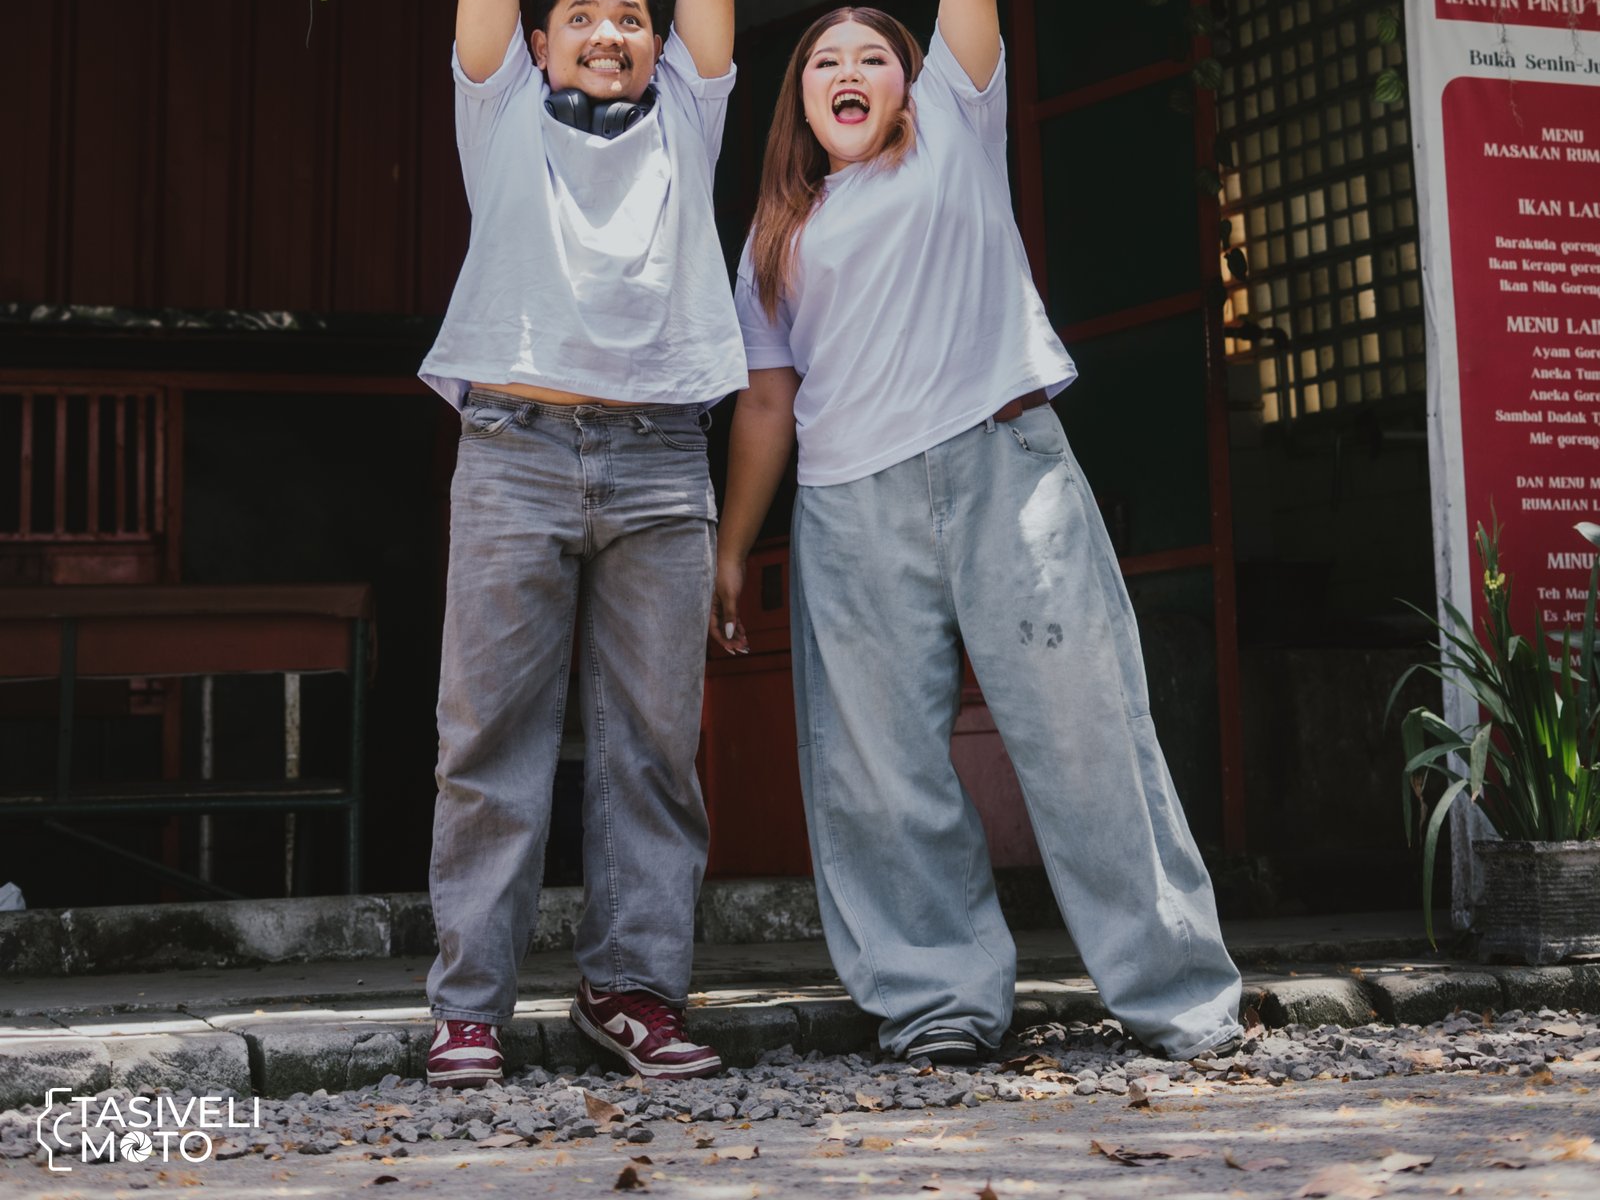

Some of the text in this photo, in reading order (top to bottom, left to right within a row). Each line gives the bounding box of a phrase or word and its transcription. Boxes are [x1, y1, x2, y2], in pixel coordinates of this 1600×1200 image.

[1470, 50, 1516, 68] Buka
[1542, 128, 1584, 143] MENU
[1484, 143, 1560, 160] MASAKAN
[1518, 199, 1562, 216] IKAN
[1495, 236, 1557, 250] Barakuda
[1488, 257, 1518, 270] Ikan
[1522, 259, 1566, 274] Kerapu
[1500, 279, 1528, 292] Ikan
[1533, 280, 1557, 293] Nila
[1507, 316, 1559, 333] MENU
[1532, 346, 1571, 360] Ayam
[1531, 368, 1571, 380] Aneka
[1530, 389, 1569, 401] Aneka
[1495, 409, 1543, 422] Sambal
[1547, 410, 1586, 423] Dadak
[1530, 432, 1553, 445] Mie
[1517, 476, 1543, 488] DAN
[1549, 477, 1585, 489] MENU
[1522, 498, 1588, 511] RUMAHAN
[1548, 552, 1598, 569] MINU
[1537, 587, 1560, 600] Teh
[1544, 609, 1558, 622] Es
